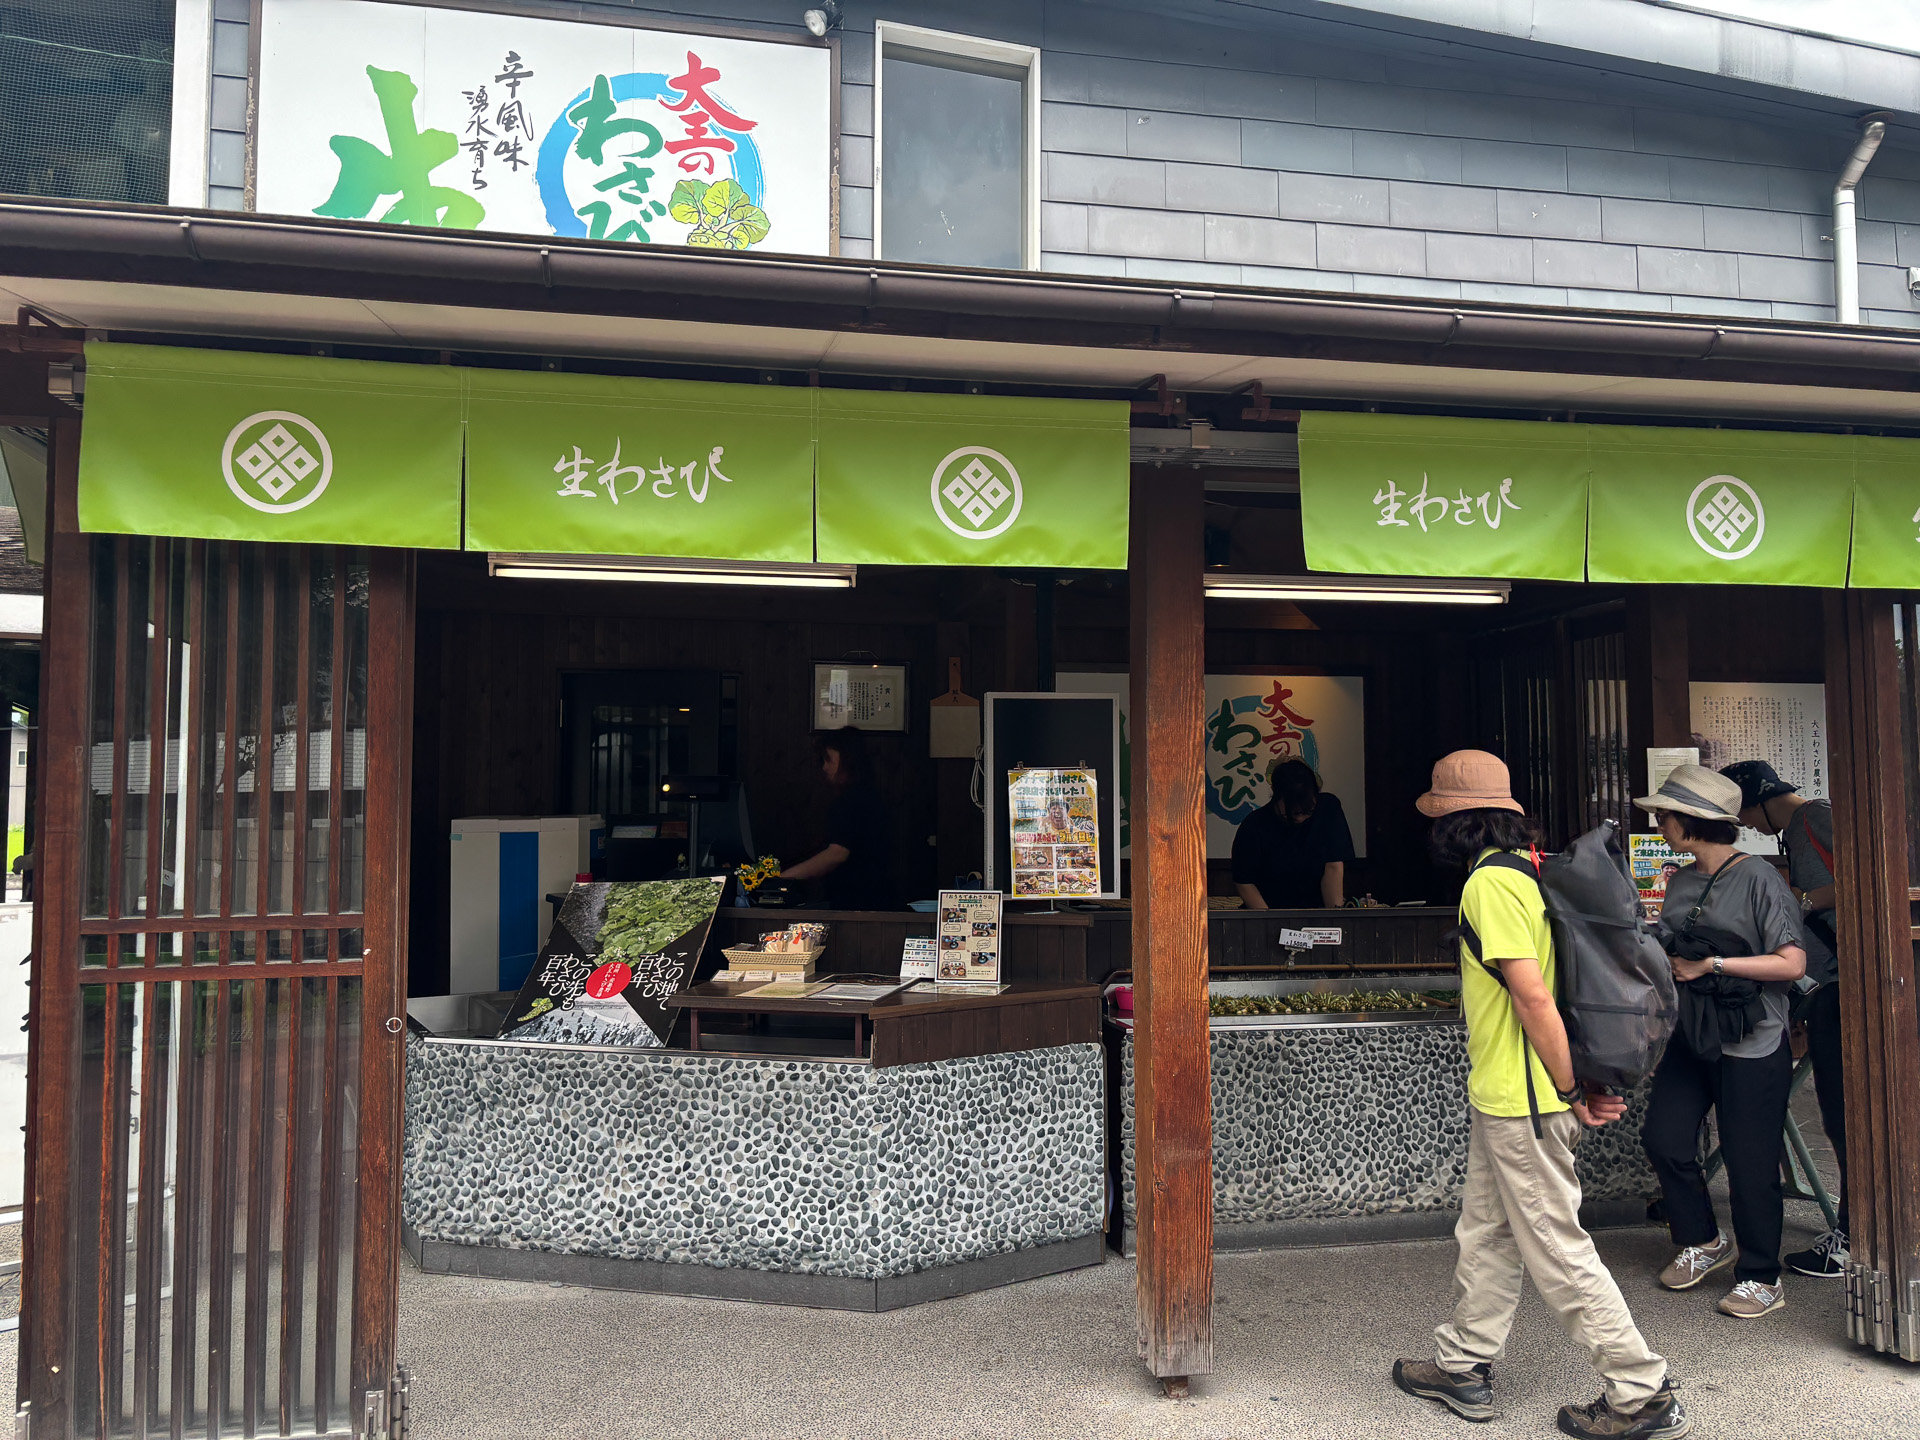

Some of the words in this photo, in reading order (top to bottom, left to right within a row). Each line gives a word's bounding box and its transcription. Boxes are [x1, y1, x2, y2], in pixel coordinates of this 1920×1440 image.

[494, 51, 534, 172] 辛風味
[658, 50, 758, 175] 大王の
[568, 74, 667, 243] わさび
[553, 436, 732, 504] 生わさび
[1372, 471, 1522, 532] 生わさび
[1258, 679, 1315, 755] 大王の
[1208, 699, 1264, 809] わさび
[536, 954, 568, 987] 百年
[549, 952, 580, 996] わさび
[562, 953, 596, 1010] この先も
[630, 953, 659, 988] 百年
[642, 952, 672, 997] わさび
